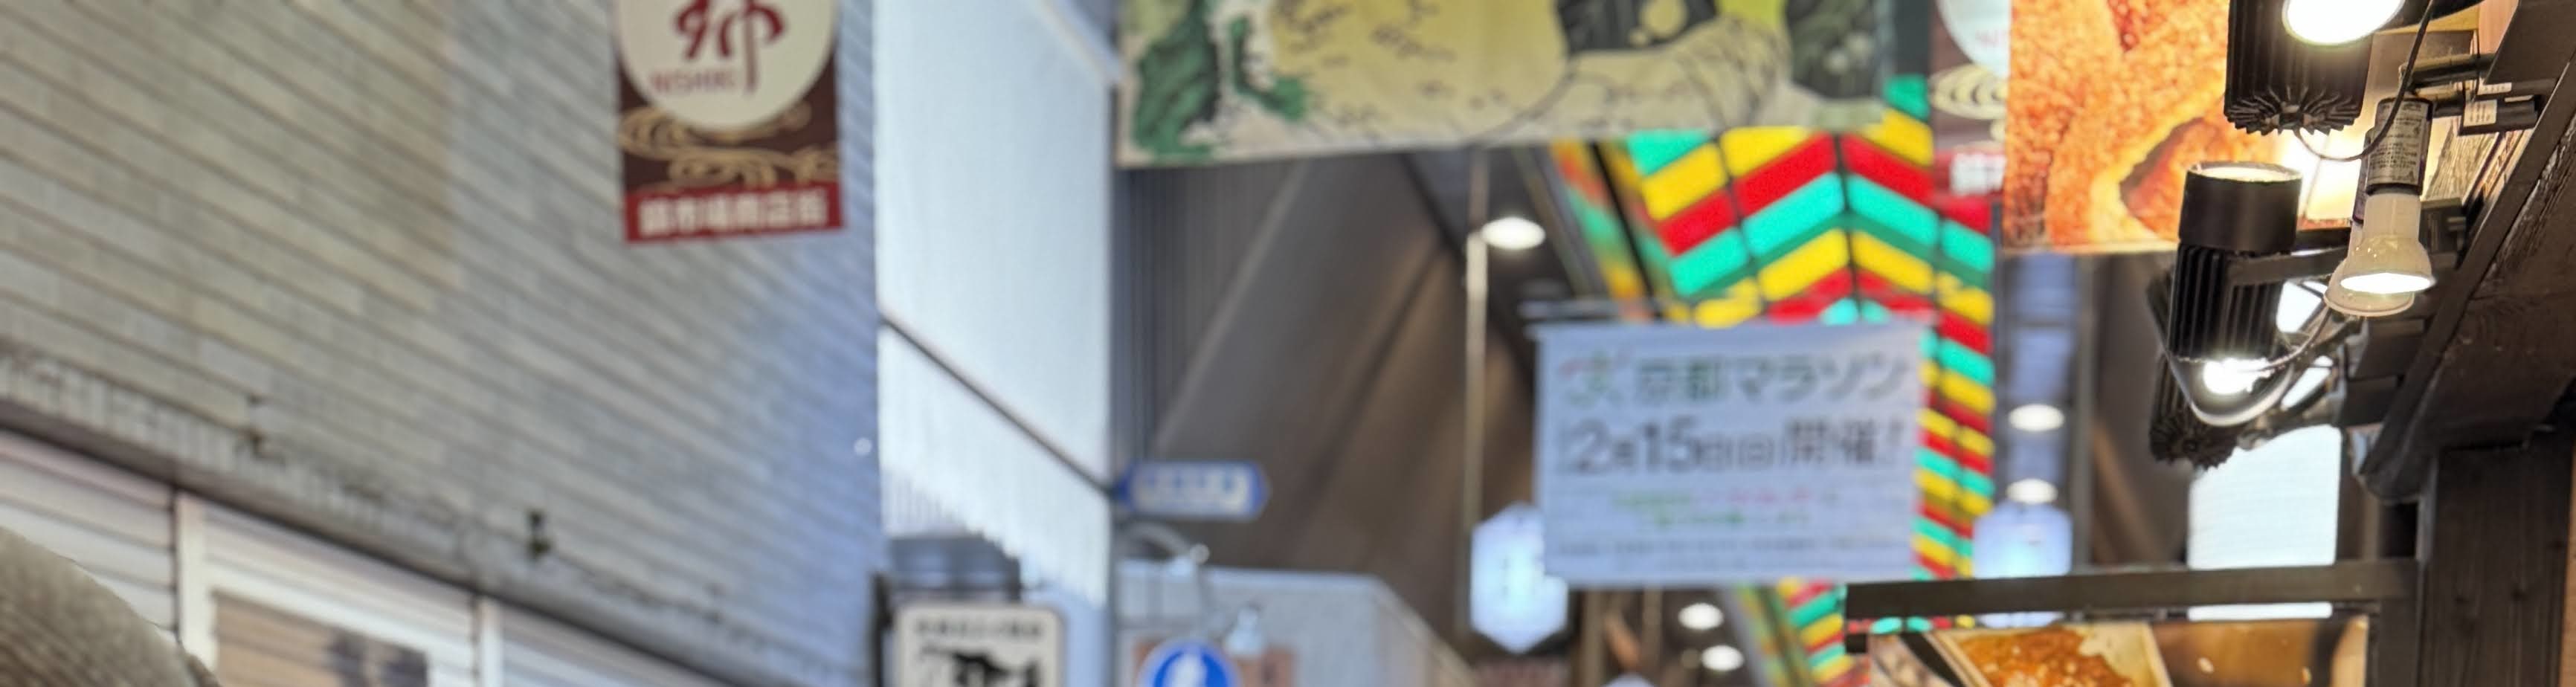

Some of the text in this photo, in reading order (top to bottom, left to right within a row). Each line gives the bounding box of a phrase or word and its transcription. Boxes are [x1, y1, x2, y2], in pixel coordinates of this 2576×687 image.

[1638, 352, 1907, 403] 京都マラソン
